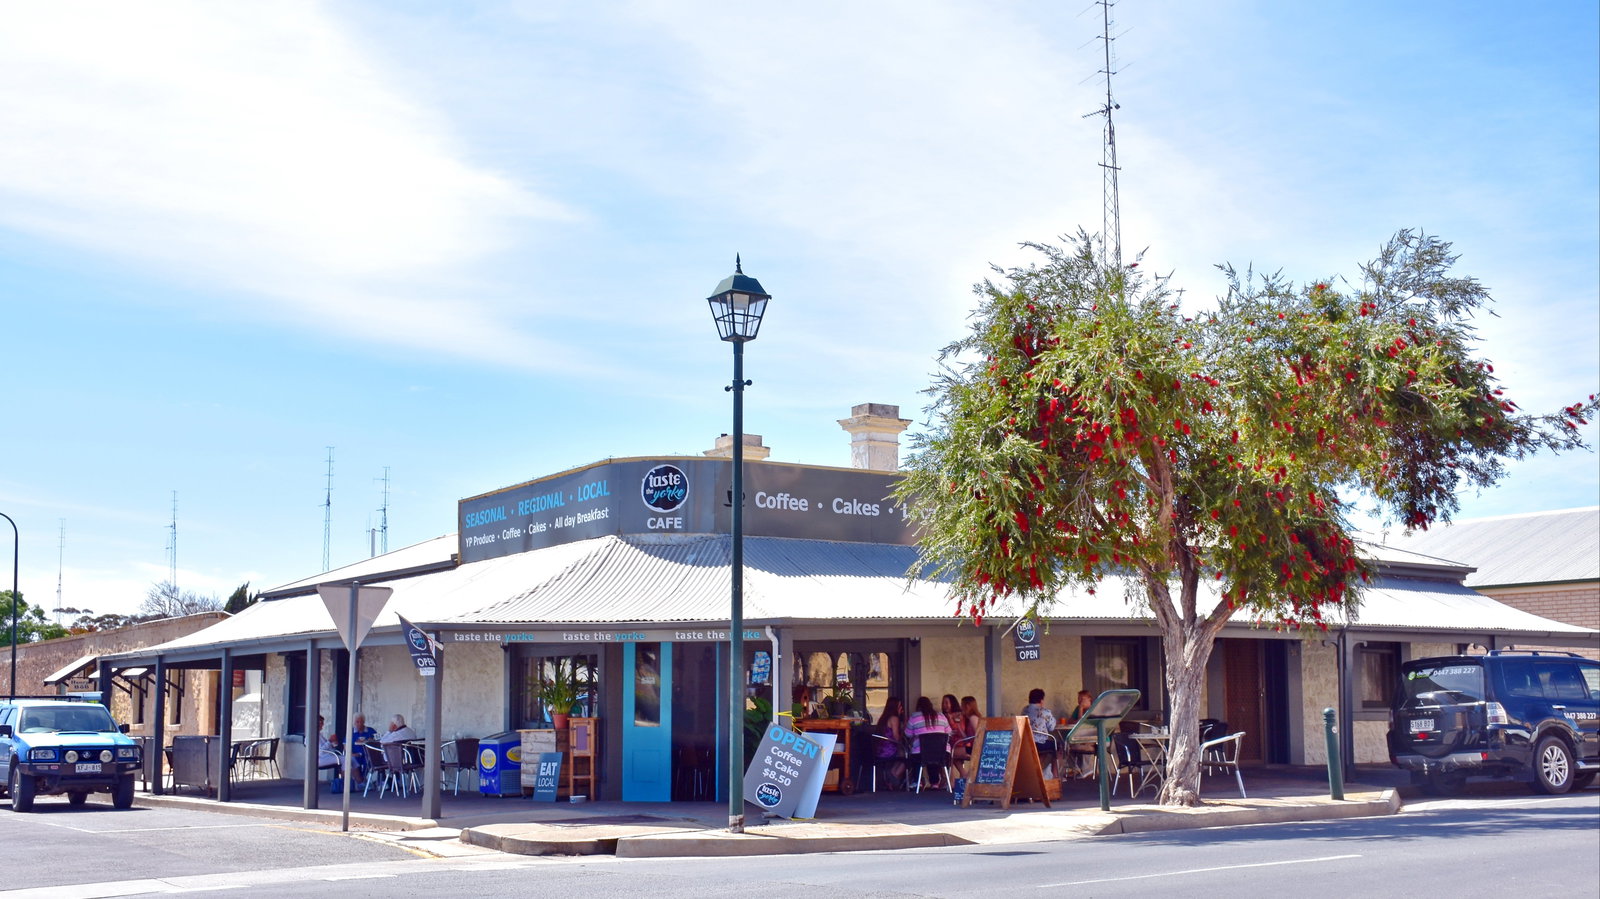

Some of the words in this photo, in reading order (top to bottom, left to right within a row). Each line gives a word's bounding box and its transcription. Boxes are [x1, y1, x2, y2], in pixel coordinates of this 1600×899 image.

[649, 472, 681, 488] taste
[650, 485, 686, 505] yorke
[465, 507, 507, 529] SEASONAL
[518, 492, 566, 517] REGIONAL
[578, 480, 610, 502] LOCAL
[755, 491, 809, 512] Coffee
[832, 497, 880, 517] Cakes
[465, 537, 473, 548] YP
[473, 533, 496, 546] Produce
[502, 527, 521, 540] Coffee
[528, 521, 547, 535] Cakes
[554, 515, 564, 529] All
[564, 514, 576, 528] day
[576, 506, 610, 524] Breakfast
[646, 516, 683, 530] CAFE
[454, 632, 481, 641] taste
[484, 632, 501, 641] the
[504, 632, 535, 644] yorke
[562, 631, 591, 641] taste
[593, 631, 612, 641] the
[614, 631, 646, 643] yorke
[675, 630, 704, 640] taste
[706, 629, 726, 639] the
[728, 629, 761, 641] rke
[1019, 649, 1038, 660] OPEN
[1462, 666, 1476, 674] 227
[1586, 712, 1597, 720] 227
[769, 727, 819, 759] OPEN
[771, 746, 802, 767] Coffee
[540, 762, 558, 776] EAT
[764, 755, 773, 766] &
[774, 761, 799, 778] Cake
[537, 777, 555, 787] LOCAL
[762, 768, 792, 787] $8.50
